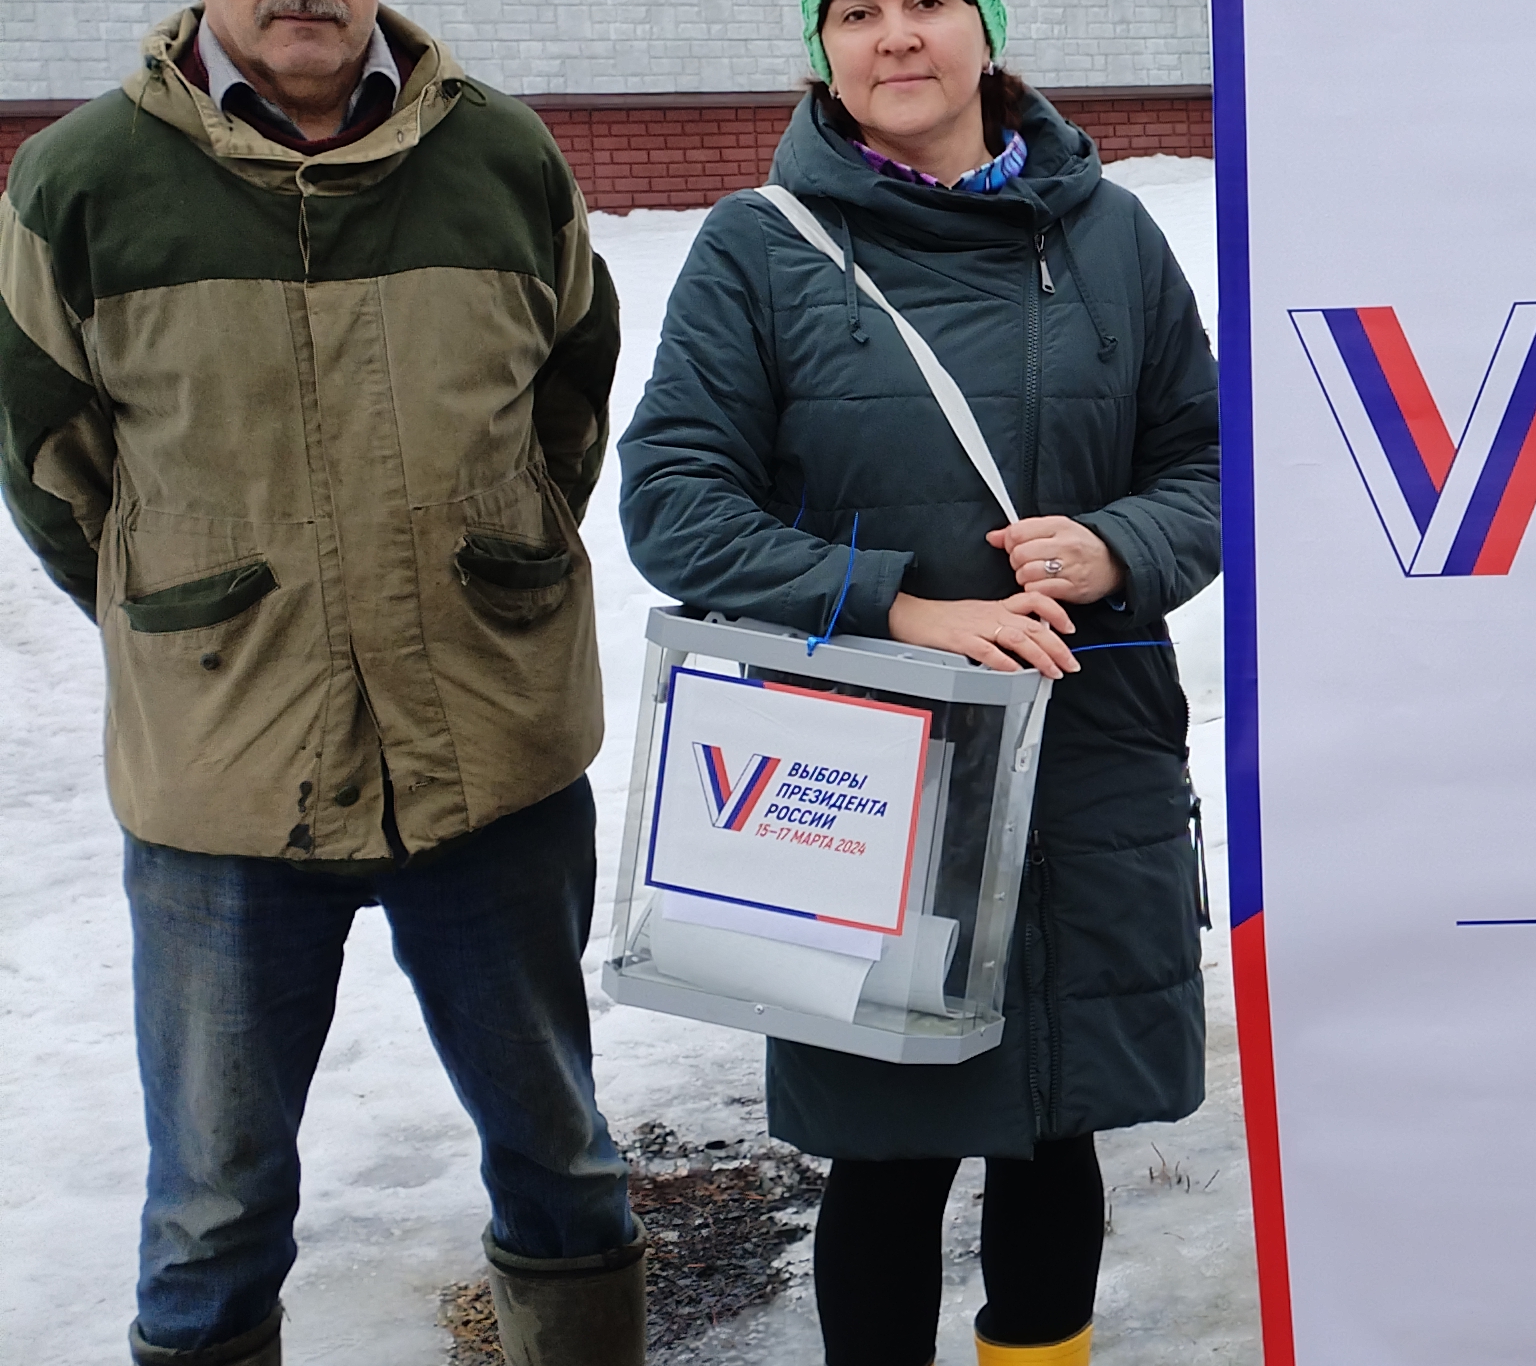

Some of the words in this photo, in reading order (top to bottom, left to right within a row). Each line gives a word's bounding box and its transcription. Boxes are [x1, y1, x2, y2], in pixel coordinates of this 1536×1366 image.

[787, 762, 868, 790] ВЫБОРЫ
[775, 782, 888, 817] ПРЕЗИДЕНТА
[764, 802, 838, 830] РОССИИ
[790, 829, 834, 850] МАРТА
[834, 838, 867, 856] 2024
